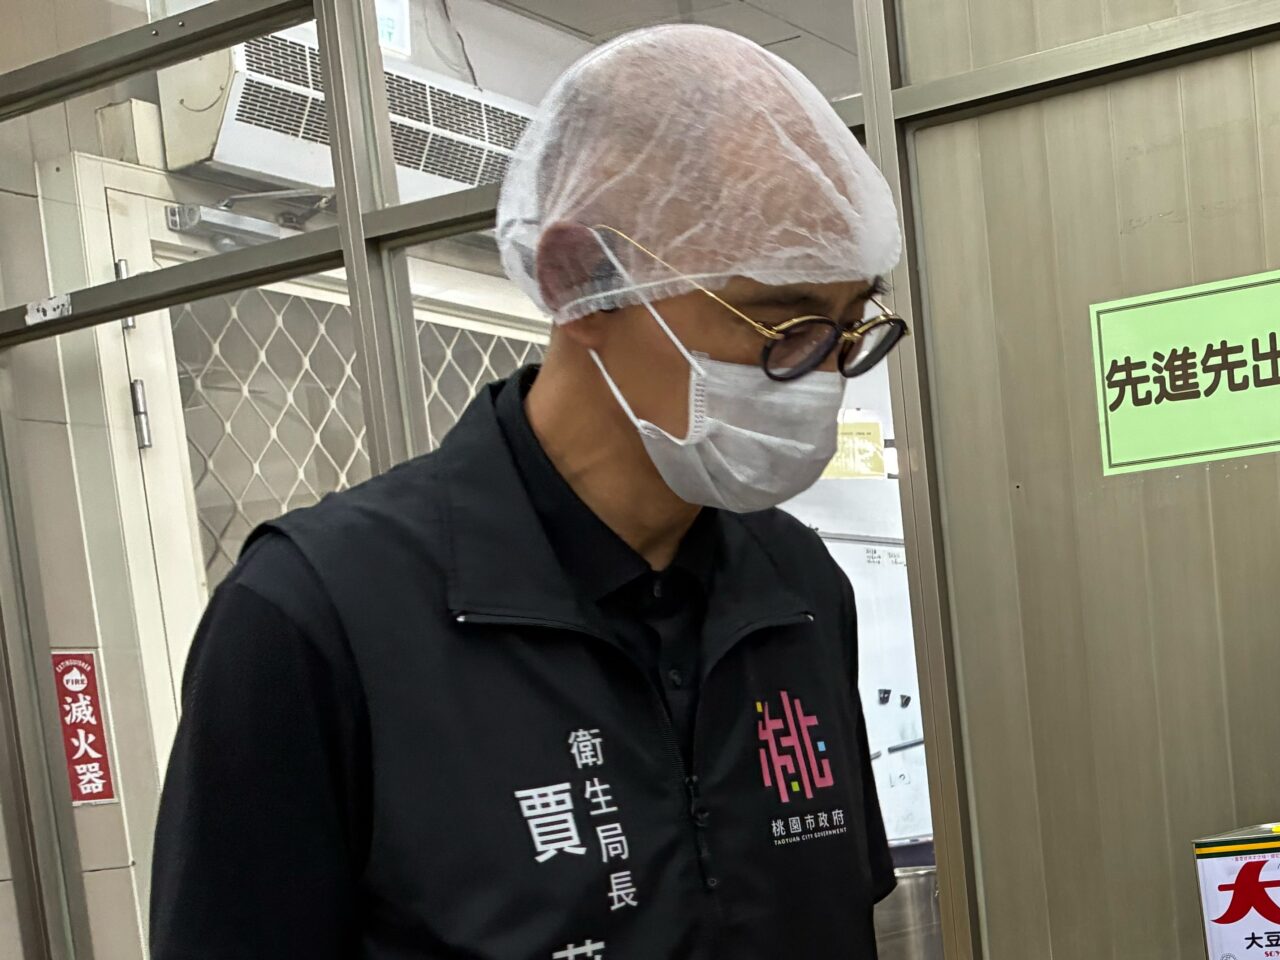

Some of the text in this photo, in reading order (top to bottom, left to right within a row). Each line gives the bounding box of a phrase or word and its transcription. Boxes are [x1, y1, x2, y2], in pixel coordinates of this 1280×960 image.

[65, 678, 86, 686] FIRE
[63, 693, 107, 795] 滅火器
[515, 782, 587, 863] 賈
[568, 729, 638, 911] 衛生局長
[771, 809, 845, 837] 桃園市政府
[774, 827, 847, 846] TAOYUAN CITY GOVERNMENT
